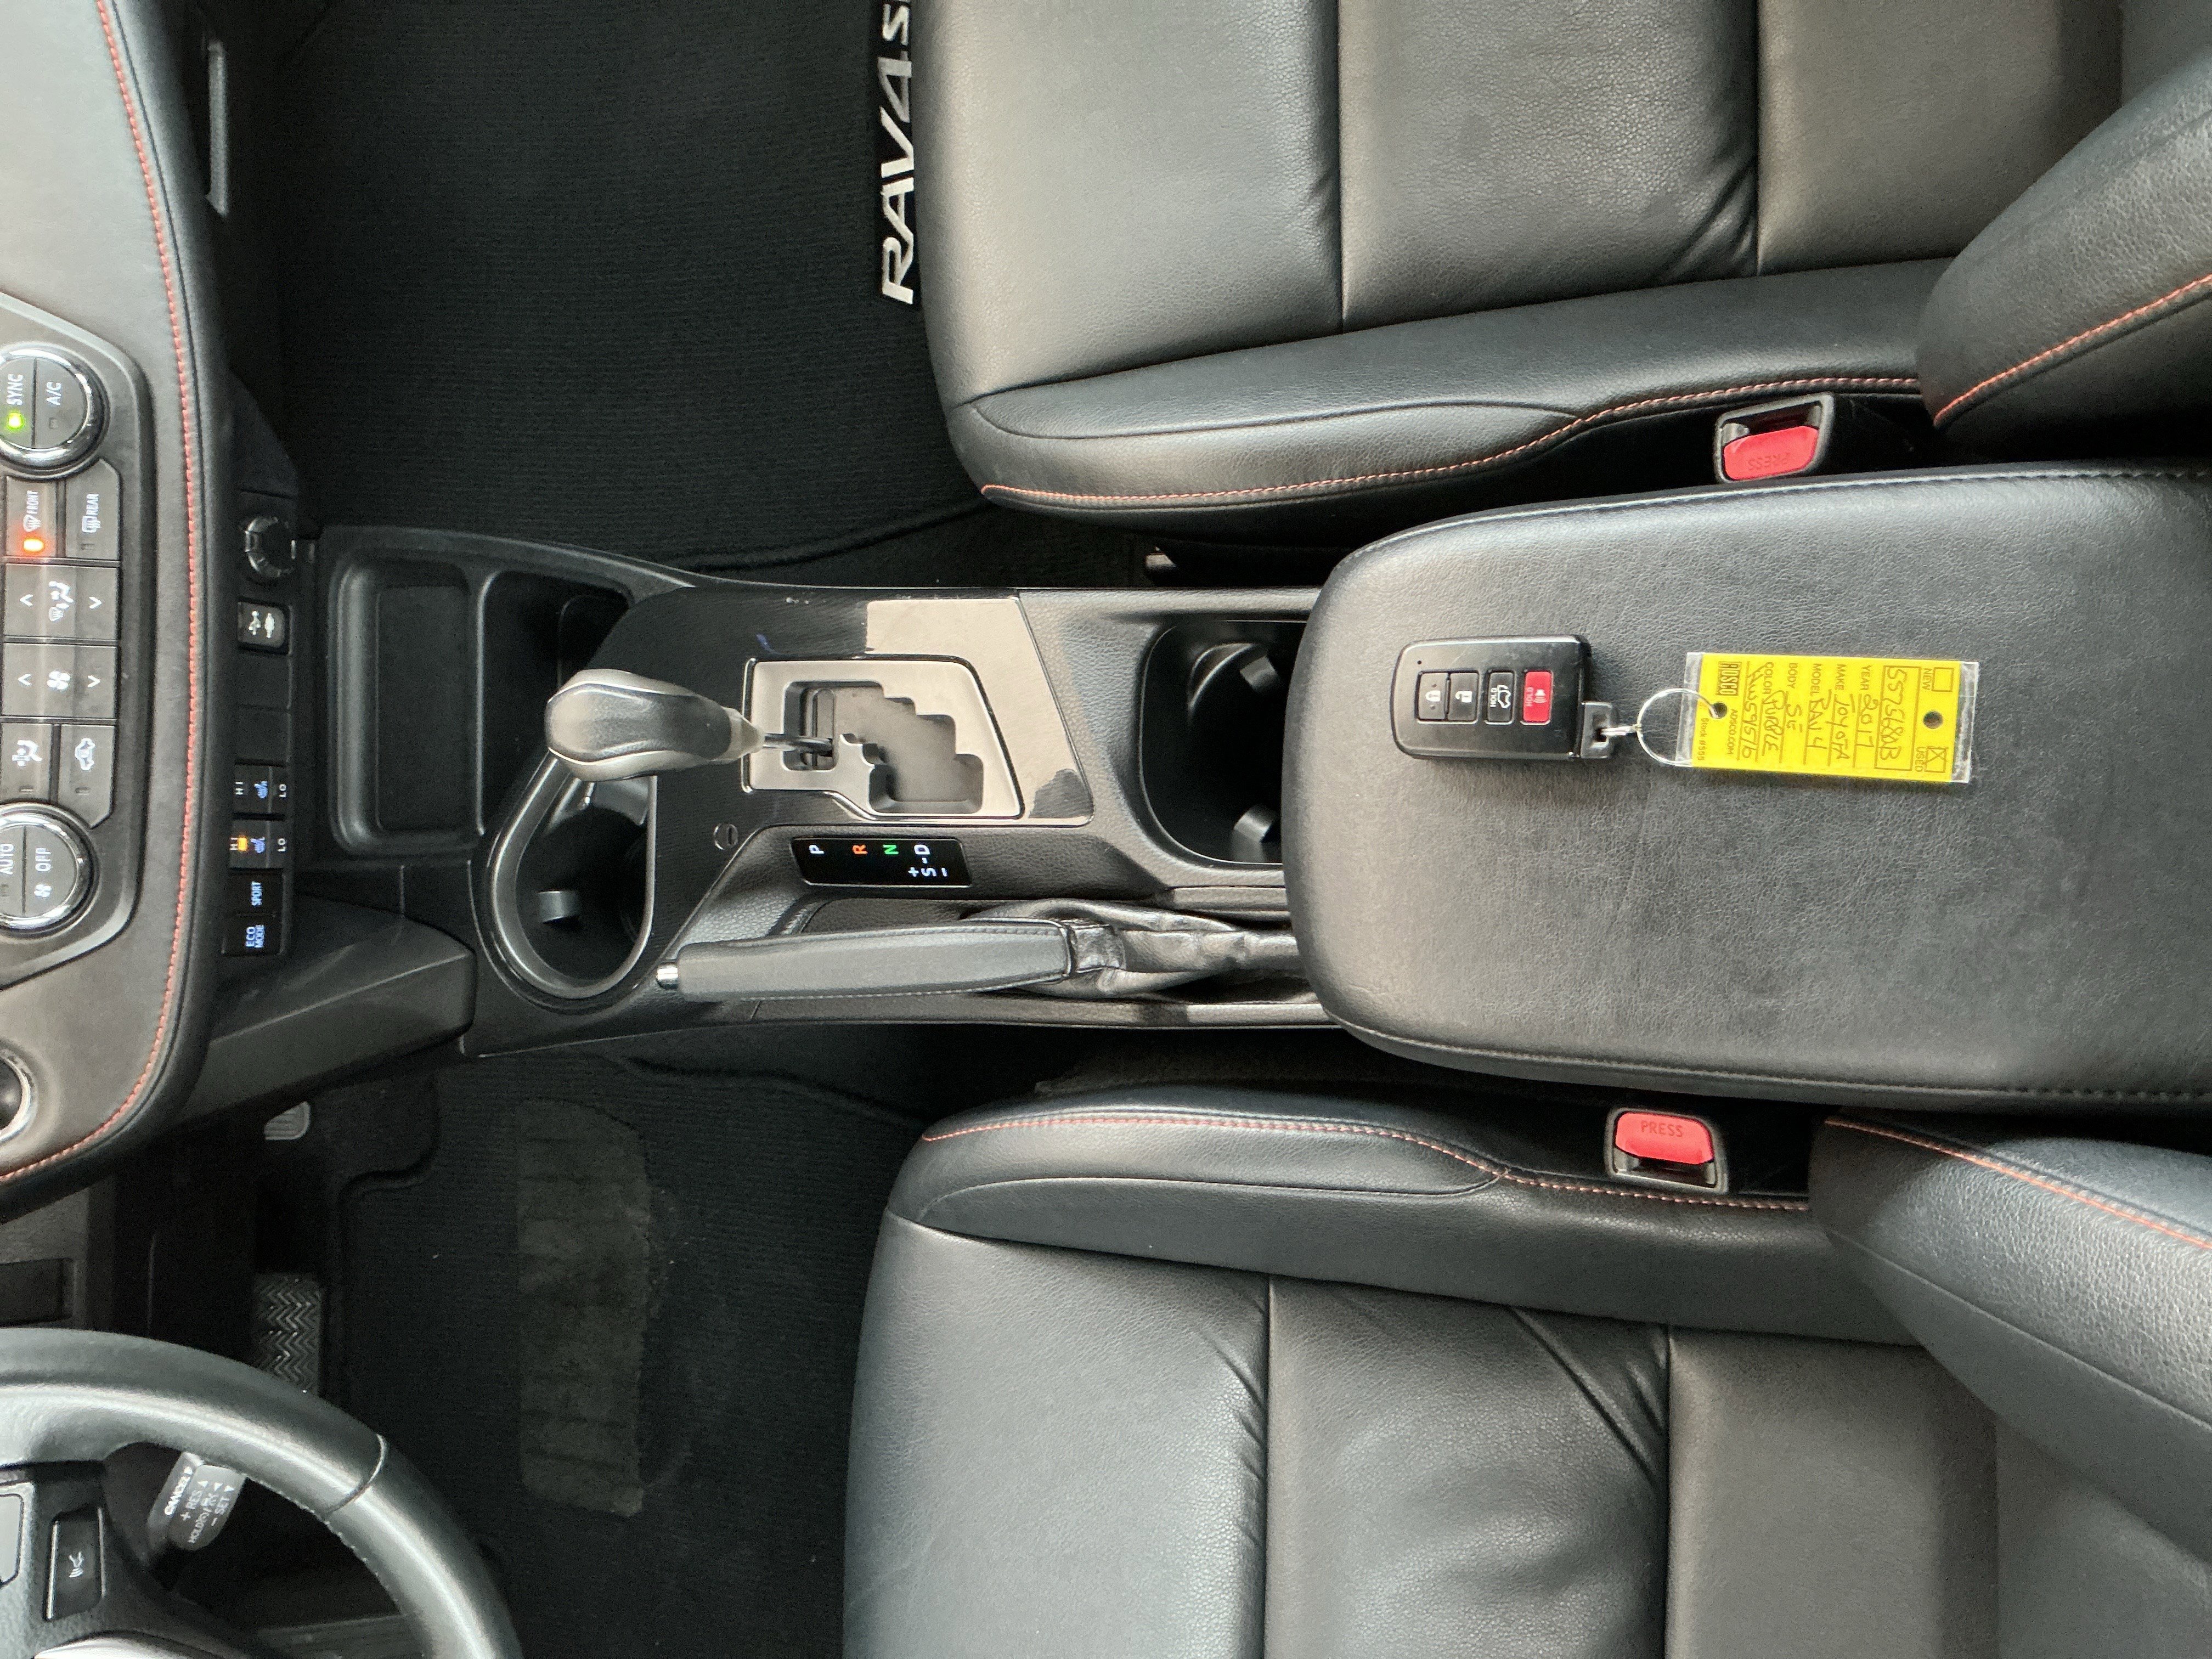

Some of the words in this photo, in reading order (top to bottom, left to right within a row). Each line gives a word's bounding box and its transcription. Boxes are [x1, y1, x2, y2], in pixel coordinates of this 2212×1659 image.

[7, 374, 24, 405] SYNC
[46, 382, 62, 406] A/C
[27, 490, 39, 514] FRONT
[87, 494, 99, 520] REAR
[1719, 662, 1741, 695] ADSCO
[1762, 662, 1774, 695] COLOR
[1787, 663, 1798, 689] BODY
[1810, 663, 1821, 696] MODEL
[1835, 664, 1846, 690] MAKE
[1860, 665, 1871, 690] YEAR
[1922, 668, 1933, 690] NEW
[1525, 687, 1534, 707] HOLD
[1761, 690, 1785, 756] PURPLE
[1786, 704, 1803, 733] SE
[1855, 694, 1880, 748] 2017
[1726, 709, 1738, 755] ADSCO.COM
[1914, 747, 1925, 772] USED
[235, 781, 244, 795] HI
[279, 783, 287, 798] LO
[277, 838, 286, 852] LO
[809, 844, 825, 855] P
[853, 844, 868, 855] R
[883, 844, 899, 855] N
[913, 844, 931, 856] D
[0, 843, 14, 875] AUTO
[35, 848, 51, 872] OFF
[251, 881, 263, 907] SPORT
[245, 926, 256, 947] ECO
[255, 924, 265, 949] MODE
[1641, 1120, 1684, 1137] PRESS
[214, 1496, 230, 1515] SET
